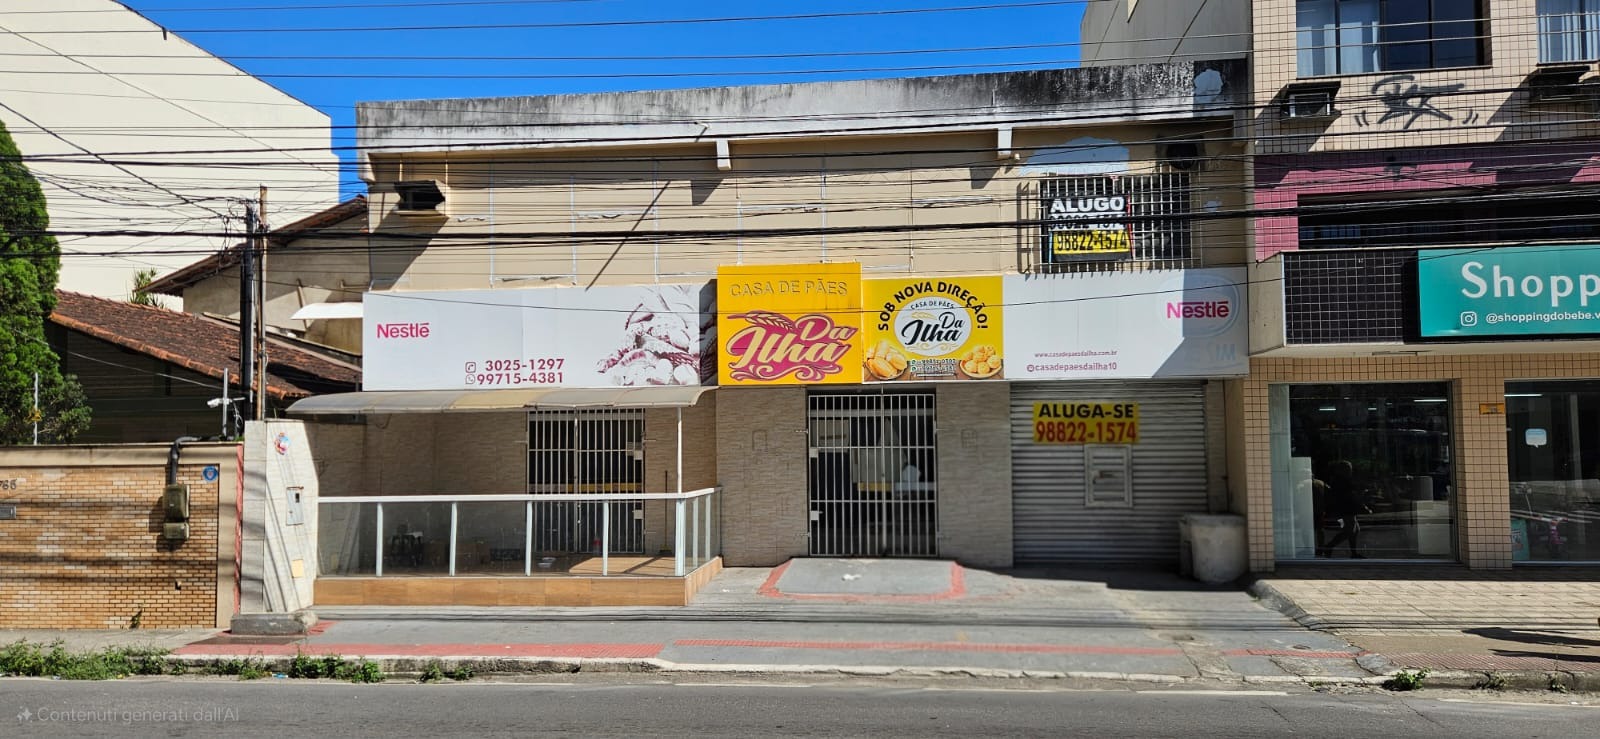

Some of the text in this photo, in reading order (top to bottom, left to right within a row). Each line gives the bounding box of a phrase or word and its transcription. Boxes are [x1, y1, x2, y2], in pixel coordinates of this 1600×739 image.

[1050, 196, 1125, 213] ALUGO
[1057, 231, 1128, 251] 98822-1574
[730, 278, 848, 297] CASA DE PÃES
[1461, 261, 1600, 307] Shopp
[878, 281, 988, 331] SOB NOVA DIREÇÃO!
[910, 299, 954, 310] CASA DE PÃES
[794, 314, 857, 342] Da
[938, 311, 965, 329] Da
[901, 319, 961, 345] Ilha
[727, 325, 850, 370] Ilha
[485, 358, 565, 372] 3025-1297
[477, 371, 564, 386] 99715-4381
[1038, 404, 1134, 419] ALUGA-SE
[1036, 421, 1137, 442] 98822-1574
